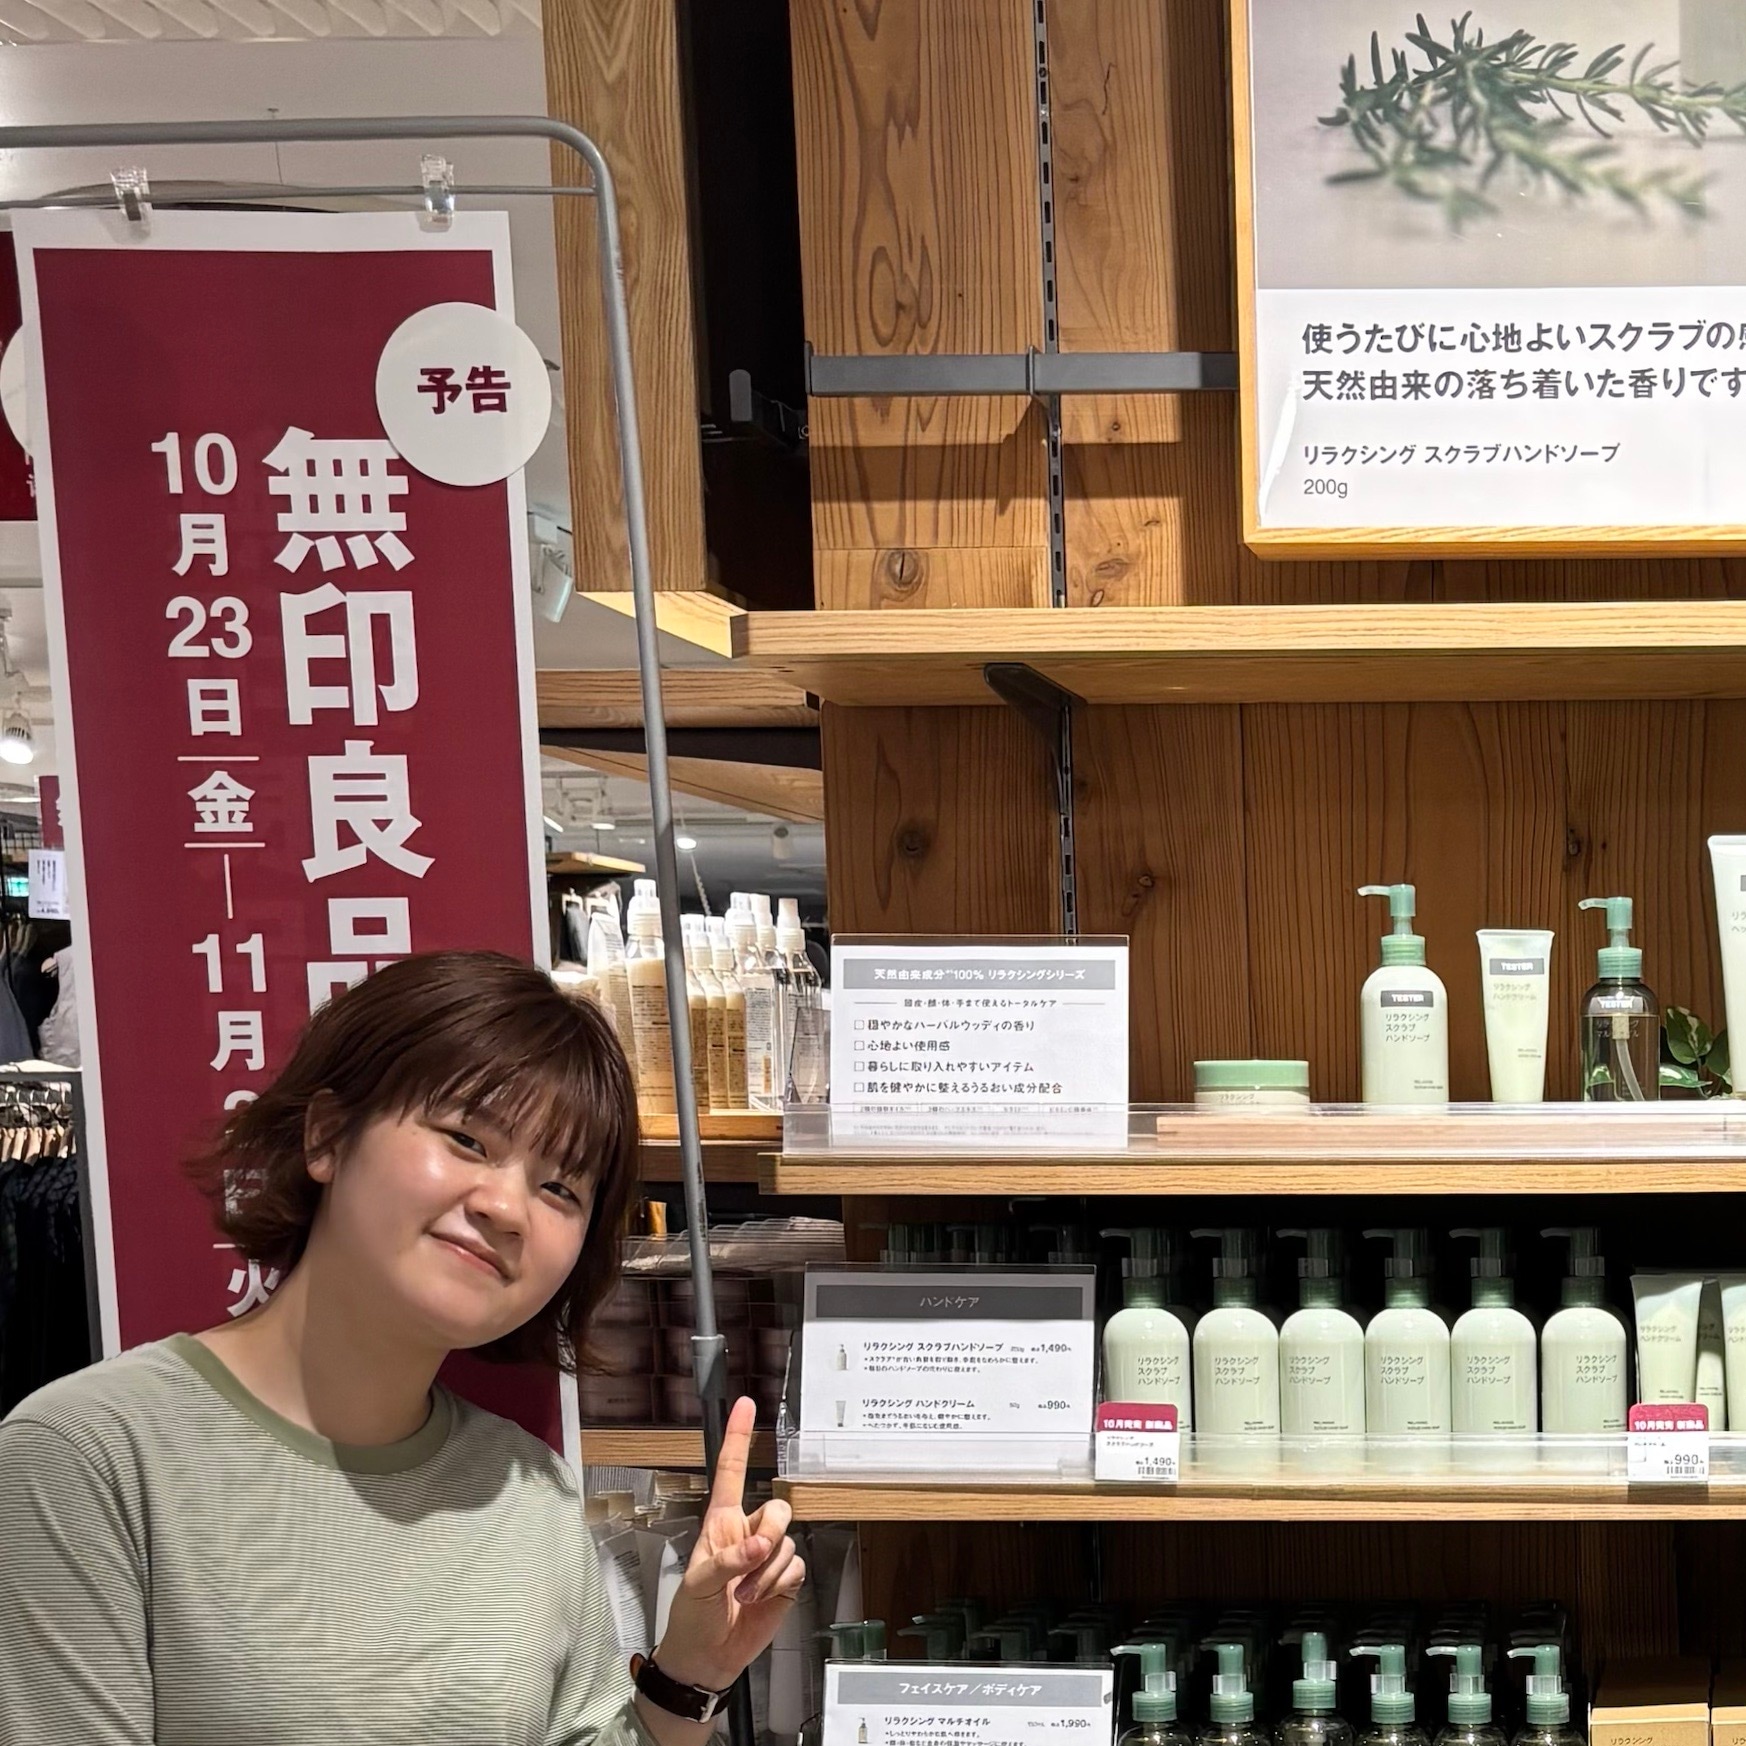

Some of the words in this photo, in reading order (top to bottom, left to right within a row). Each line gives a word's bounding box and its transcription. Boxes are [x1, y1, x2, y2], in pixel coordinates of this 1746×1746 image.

[417, 366, 511, 414] 予告
[1305, 445, 1416, 465] リラクシング
[1425, 443, 1620, 464] スクラブハンドソープ
[1304, 479, 1347, 498] 200g
[262, 426, 435, 1017] 無印良品
[188, 770, 256, 833] 金
[868, 1020, 1034, 1031] 穏やかなハーバルウッディの香り
[868, 1040, 950, 1051] 心地よい使用感
[868, 1061, 1033, 1072] 暮らしに取り入れやすいアイテム
[867, 1082, 1062, 1094] 肌を健やかに整えるうるおい成分配合
[920, 1296, 979, 1308] ハンドケア
[863, 1399, 912, 1408] リラクシング
[916, 1400, 974, 1408] ハンドクリーム
